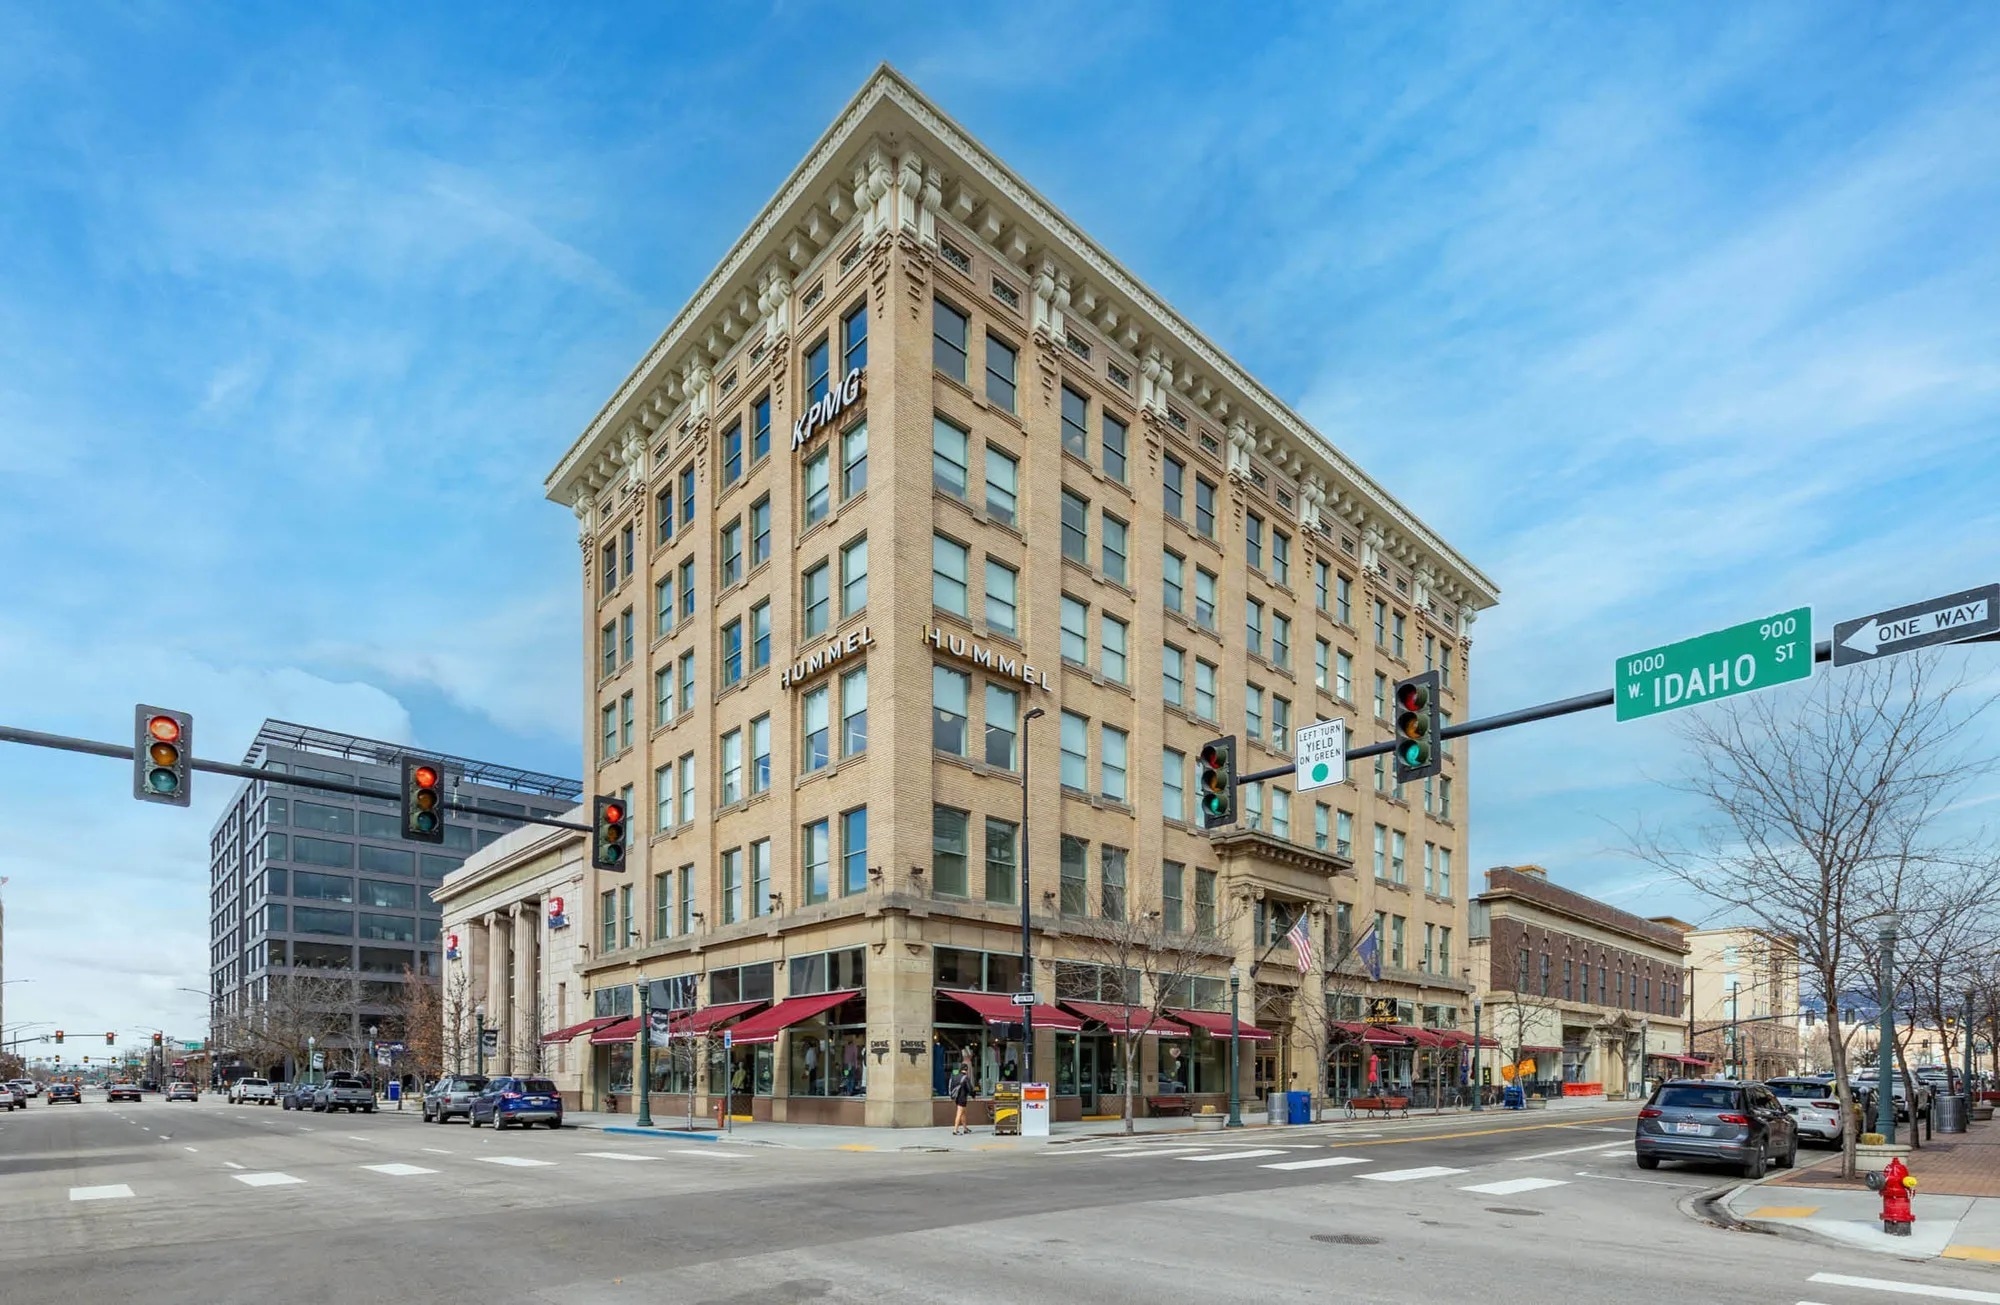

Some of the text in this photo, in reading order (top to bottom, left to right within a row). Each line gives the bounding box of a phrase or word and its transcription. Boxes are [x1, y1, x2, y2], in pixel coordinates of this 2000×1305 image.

[791, 367, 861, 451] KPMG
[1759, 617, 1797, 641] 900
[1879, 603, 1981, 642] ONE WAY
[781, 626, 877, 690] HUMMEL
[922, 624, 1053, 692] HUMMEL
[1627, 653, 1665, 677] 1000
[1627, 642, 1797, 707] W. IDAHO ST
[1299, 724, 1341, 742] LEFT TURN
[1306, 737, 1334, 753] YIELD
[1299, 748, 1341, 765] ON GREEN
